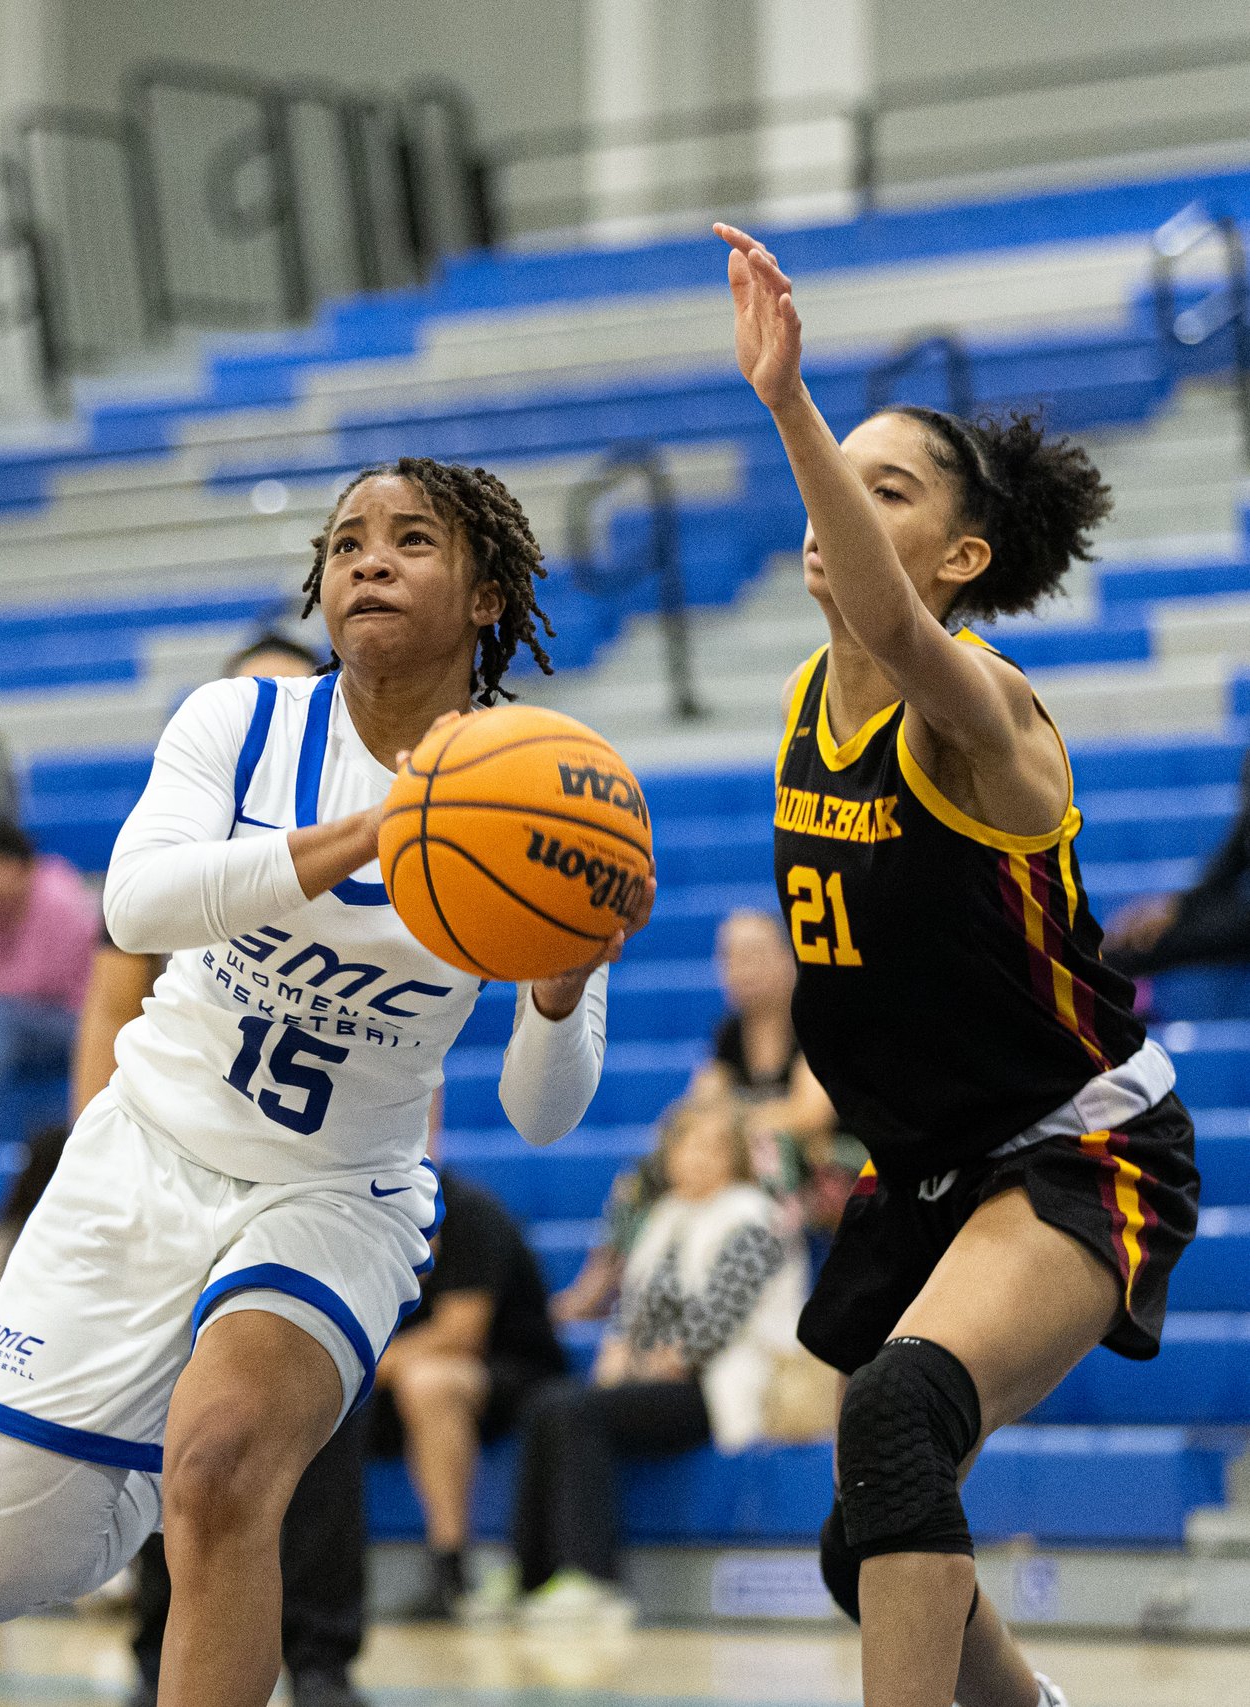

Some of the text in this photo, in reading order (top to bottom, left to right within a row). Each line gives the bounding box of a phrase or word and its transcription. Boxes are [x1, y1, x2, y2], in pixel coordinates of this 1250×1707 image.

[558, 763, 648, 830] NCAA
[525, 830, 645, 919] Wilson
[787, 864, 864, 967] 21
[202, 949, 421, 1048] BASKETBA
[226, 950, 404, 1030] WOMEN'
[229, 925, 453, 1018] SMC
[222, 1015, 350, 1136] 15
